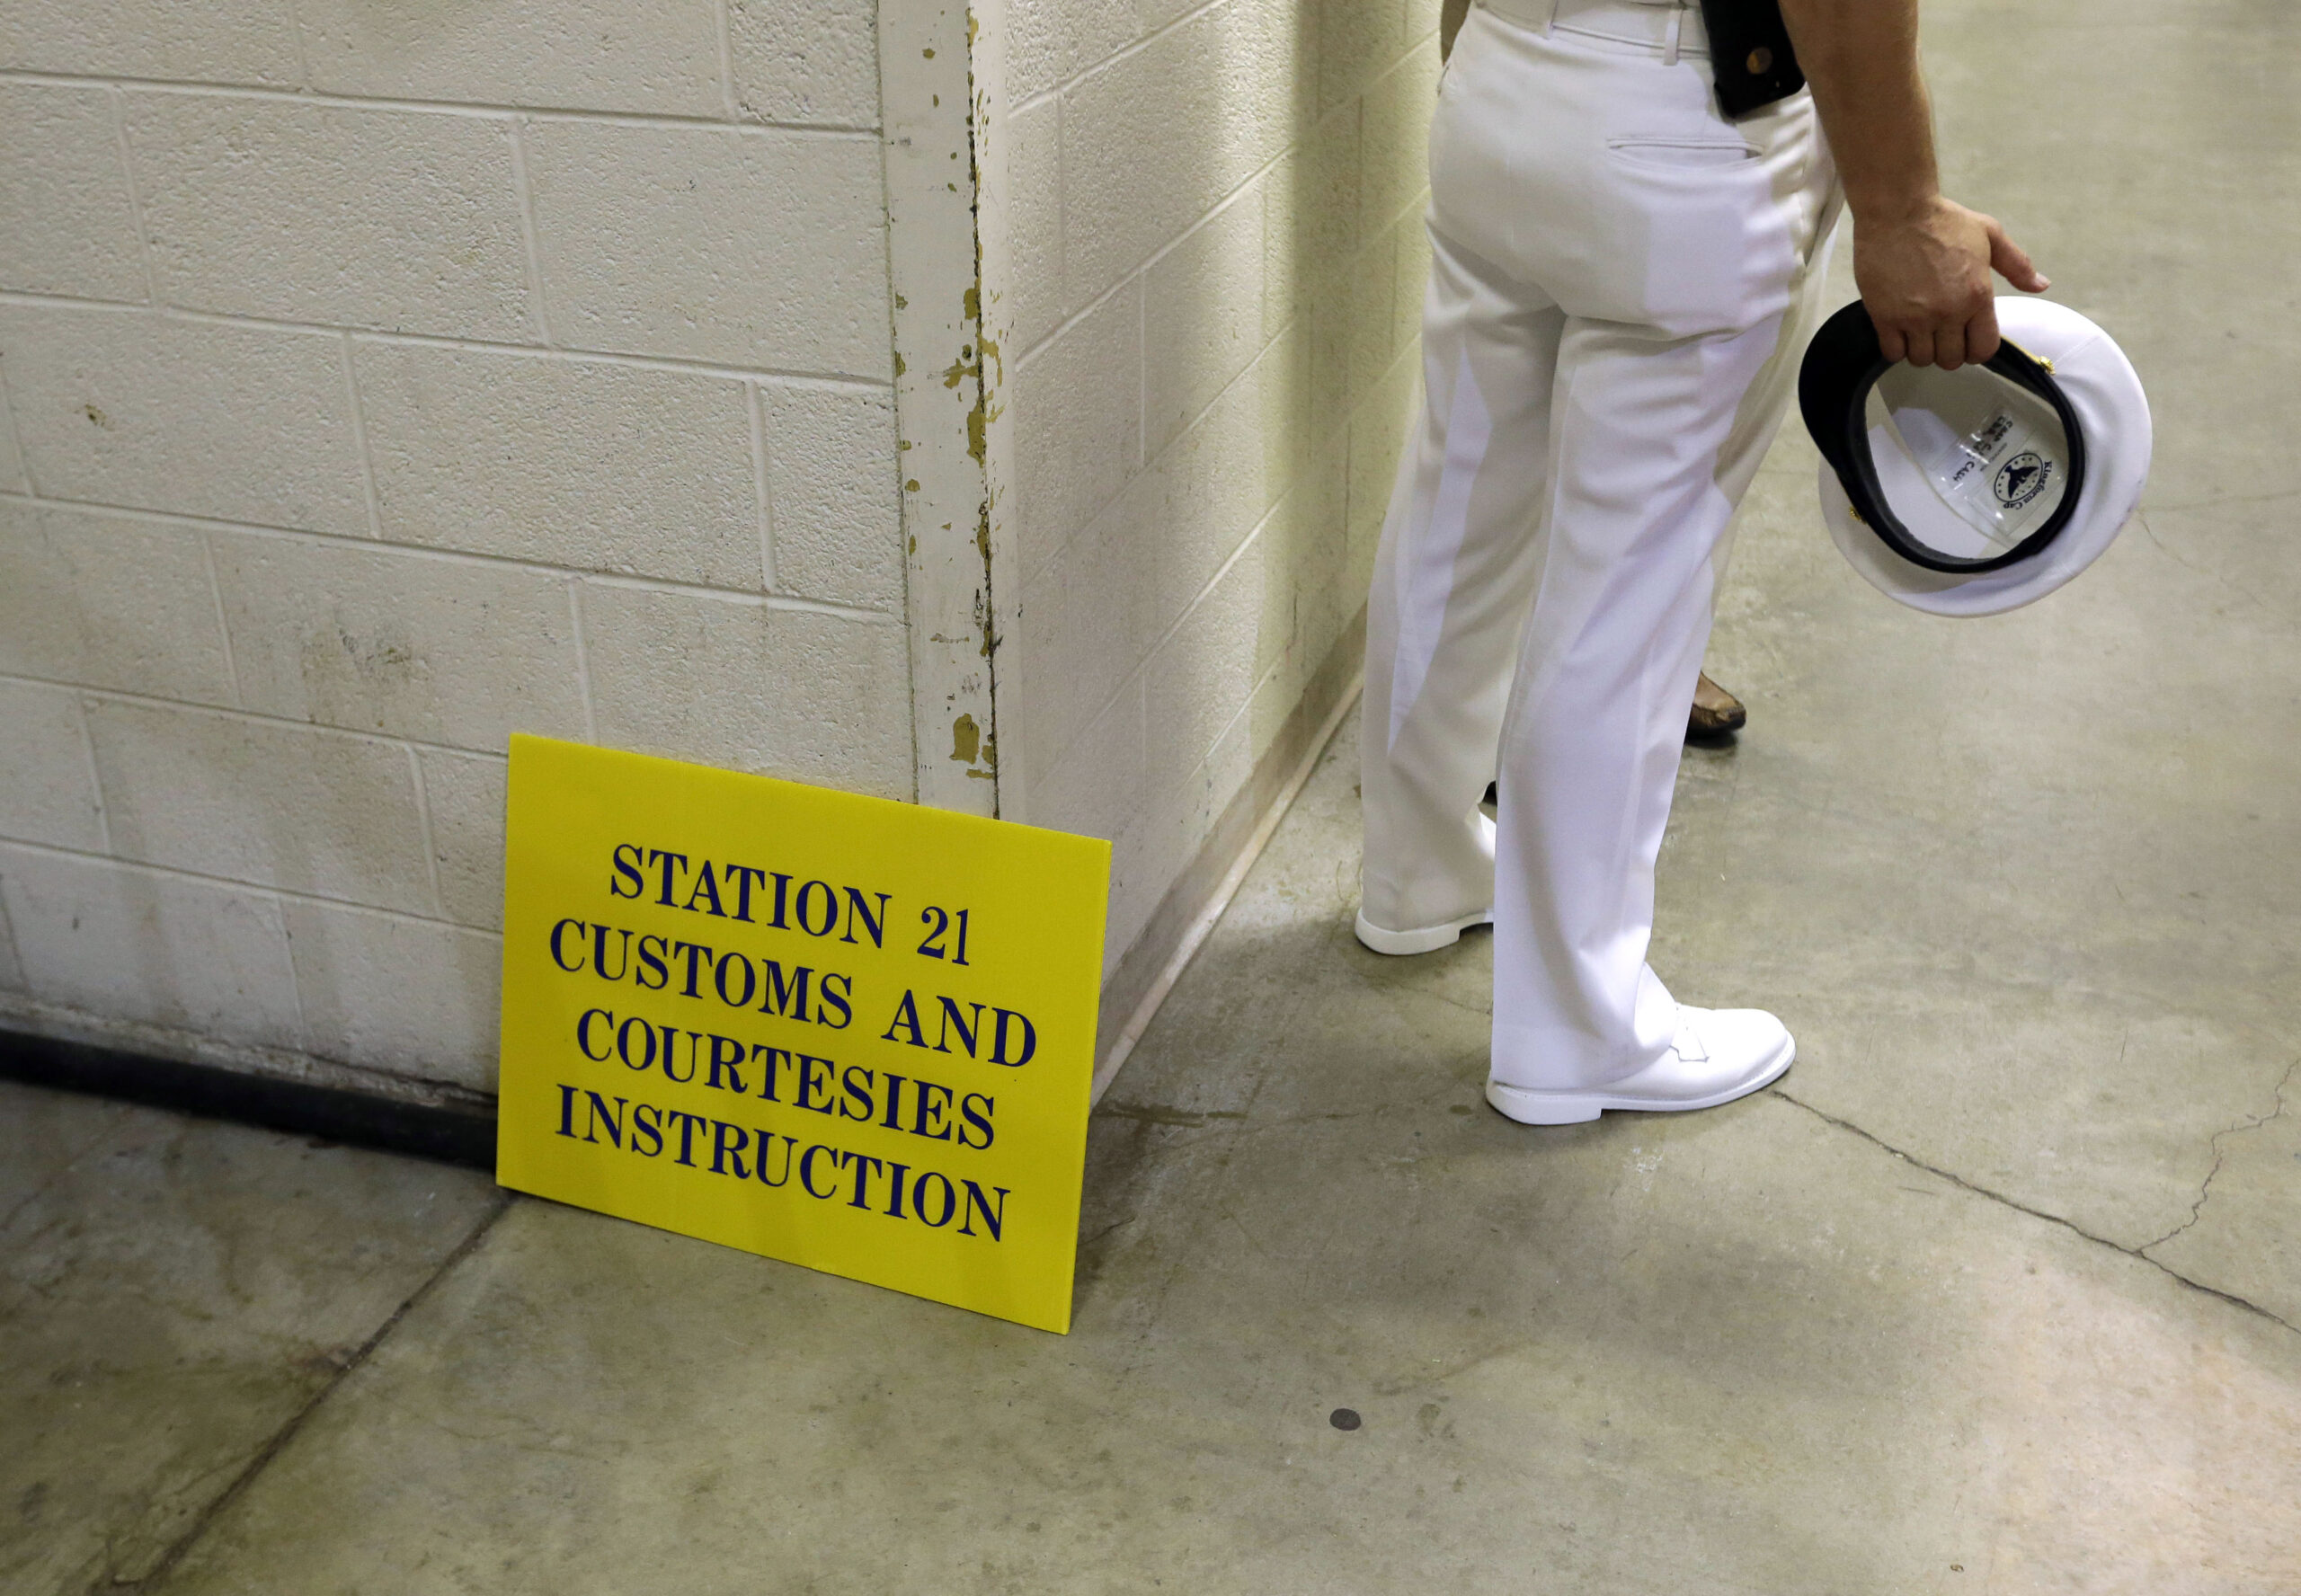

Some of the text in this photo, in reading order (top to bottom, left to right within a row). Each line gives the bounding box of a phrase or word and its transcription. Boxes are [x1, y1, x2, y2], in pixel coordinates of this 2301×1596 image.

[2003, 460, 2053, 510] Kingform Cap
[610, 843, 970, 966] STATION 21
[549, 918, 1036, 1068] CUSTOMS AND
[576, 1008, 995, 1150] COURTESIES
[555, 1083, 1011, 1243] INSTRUCTION
